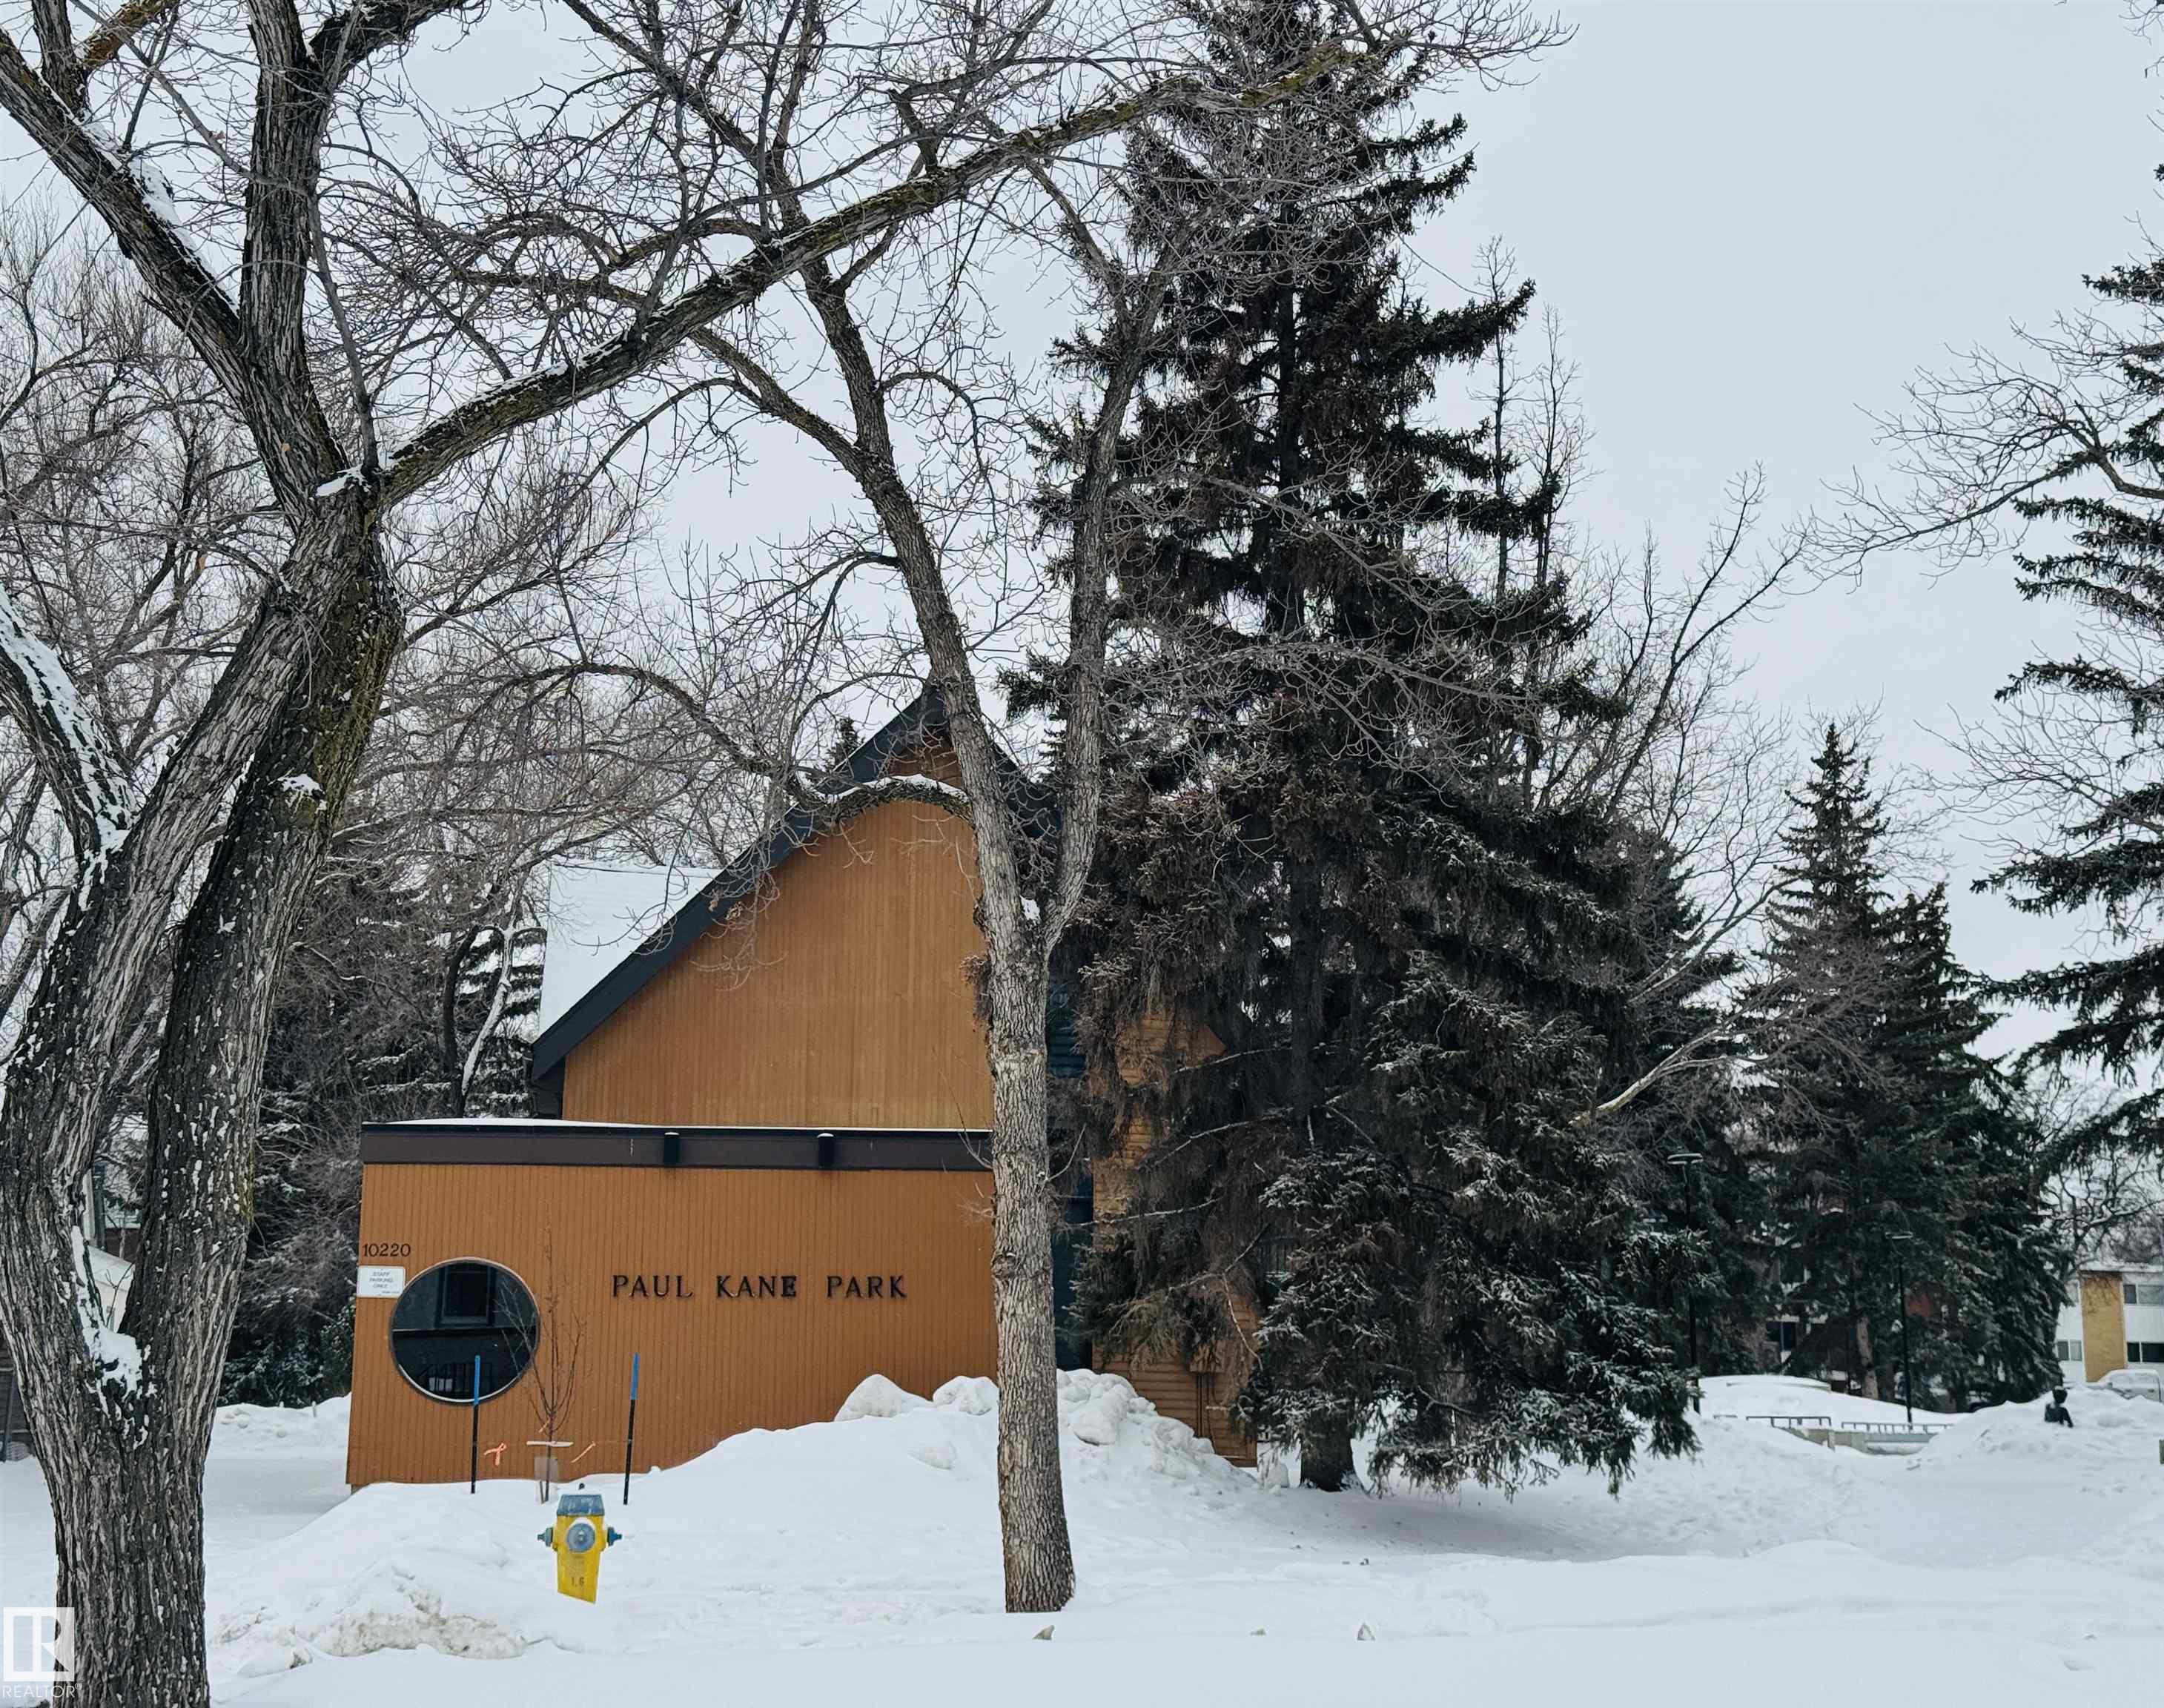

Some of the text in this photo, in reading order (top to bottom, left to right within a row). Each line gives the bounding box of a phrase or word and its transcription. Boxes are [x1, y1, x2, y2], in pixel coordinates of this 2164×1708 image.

[362, 1243, 411, 1257] 10220
[612, 1275, 907, 1298] PAUL KANE PARK
